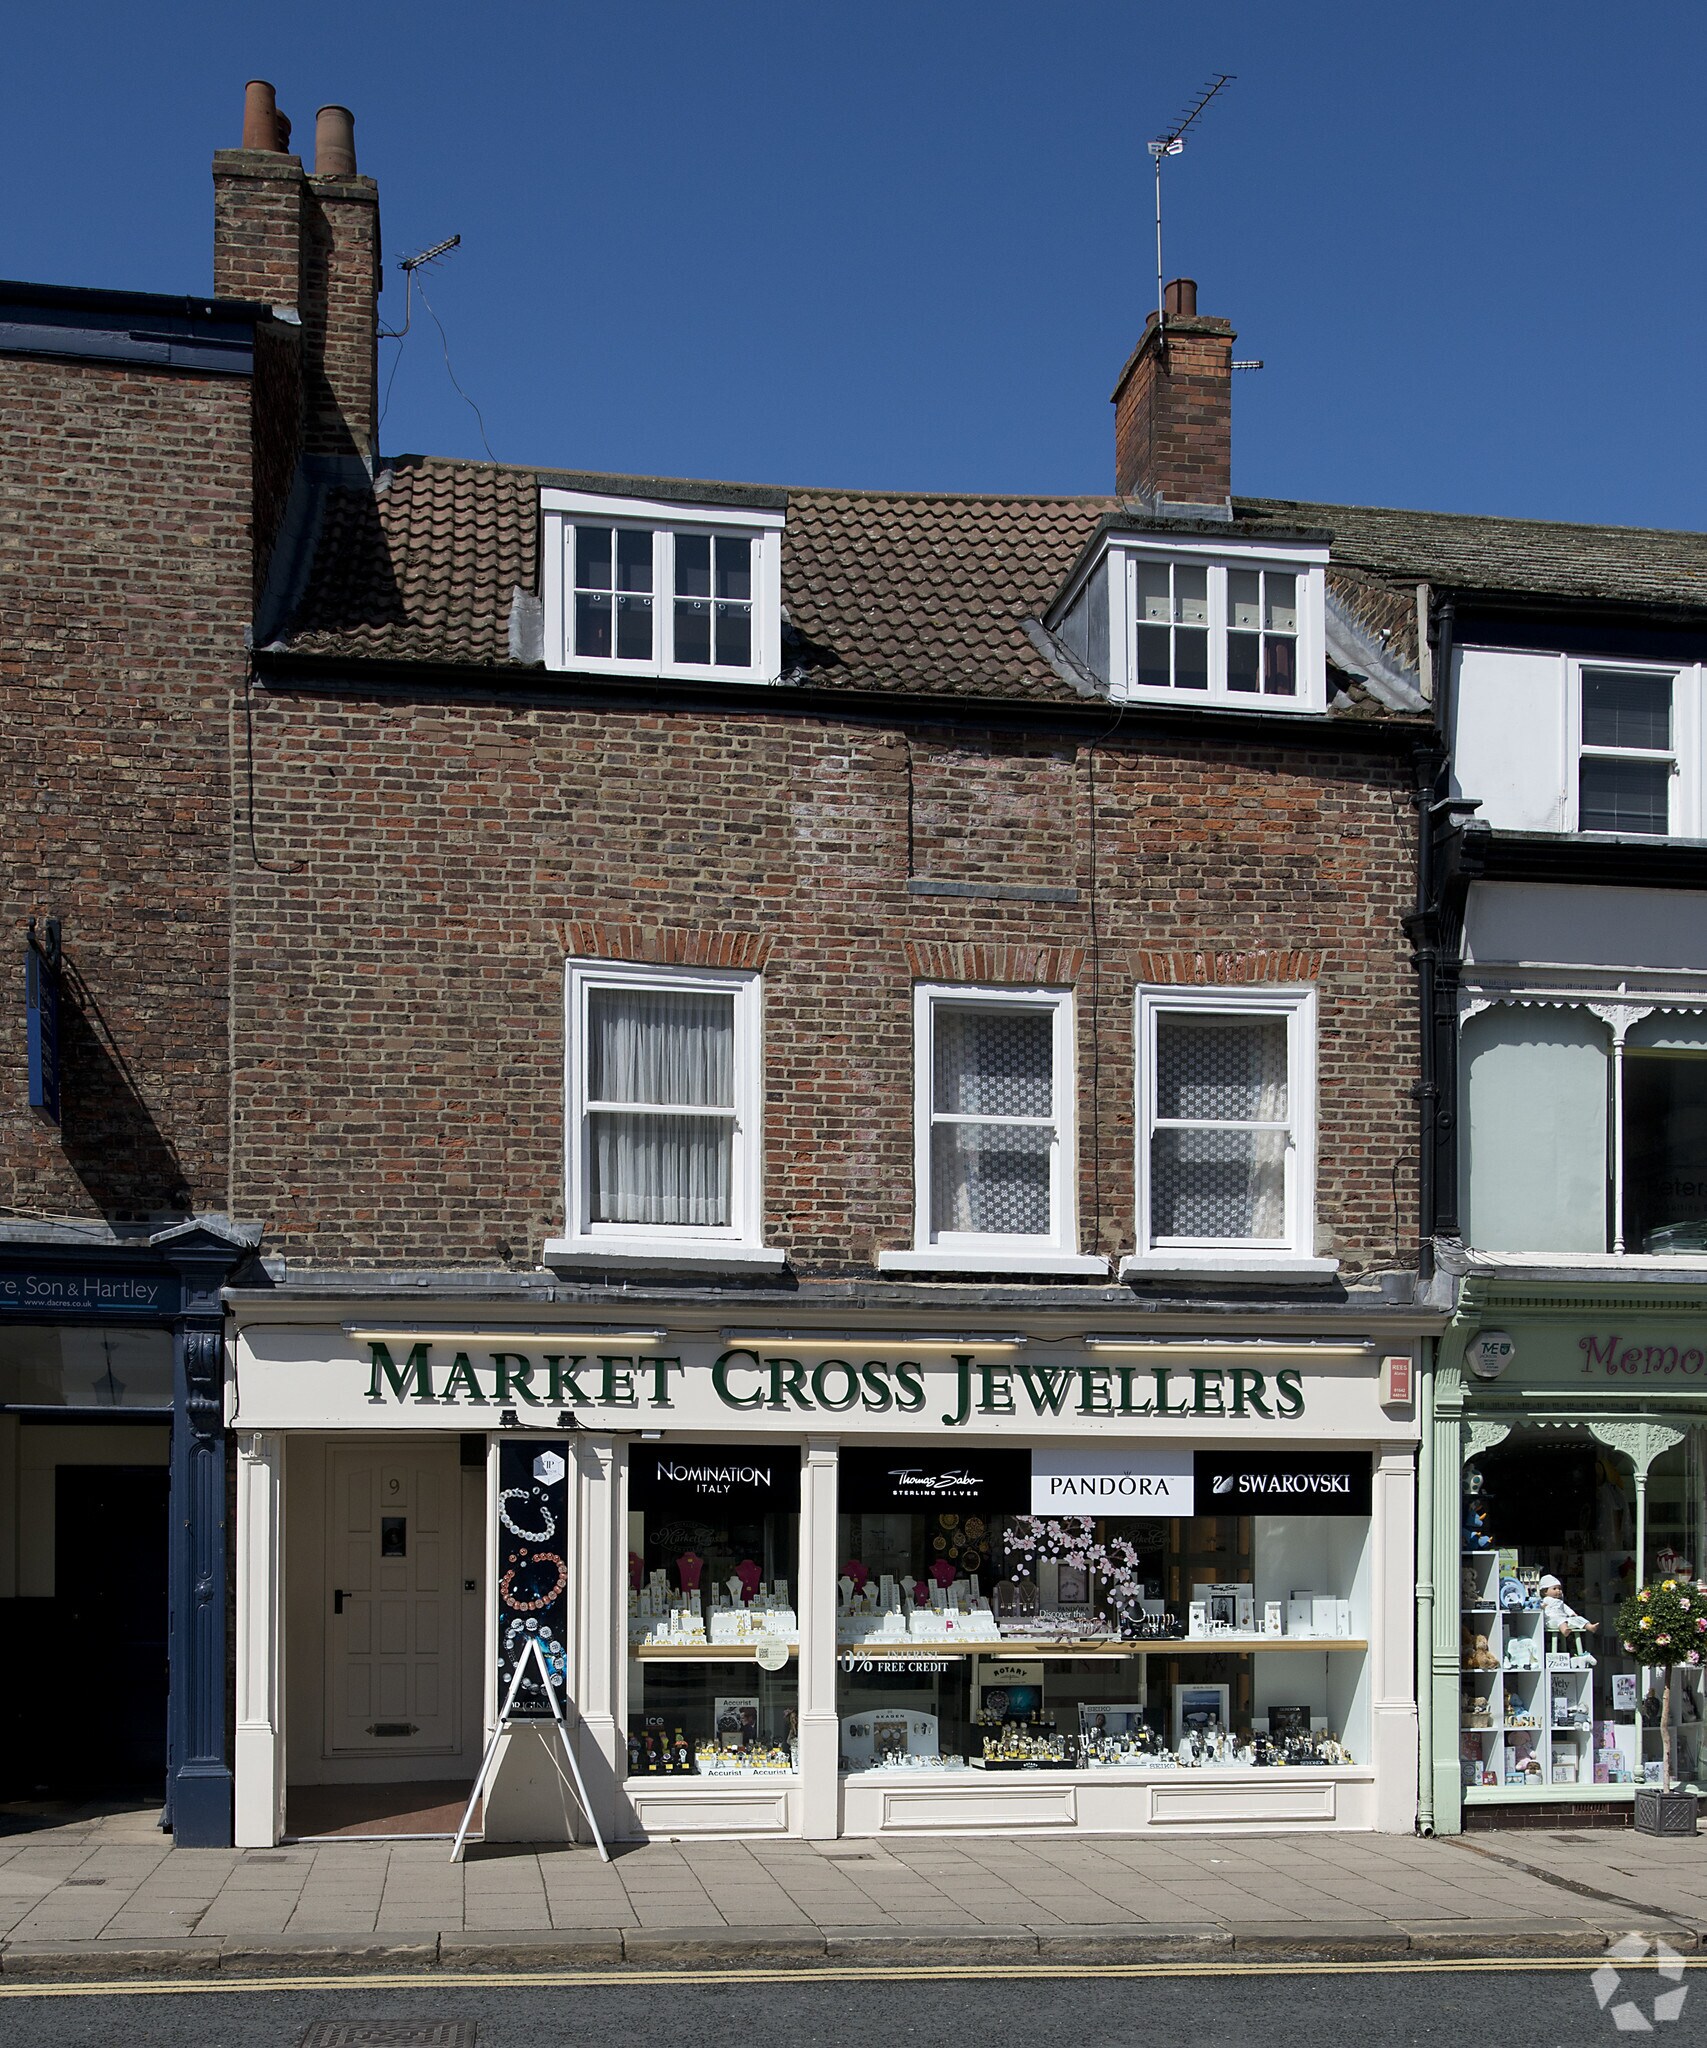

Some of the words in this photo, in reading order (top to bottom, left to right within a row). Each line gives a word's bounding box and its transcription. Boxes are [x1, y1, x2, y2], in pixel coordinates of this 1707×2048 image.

[26, 1276, 63, 1296] Son
[67, 1282, 79, 1296] &
[83, 1278, 158, 1304] Hartley
[24, 1299, 92, 1308] www.dacres.co.uk
[1578, 1335, 1707, 1376] Memo
[364, 1342, 682, 1403] MARKET
[712, 1348, 924, 1407] CROSS
[941, 1354, 1305, 1426] JEWELLERS
[389, 1478, 400, 1496] 9
[696, 1484, 731, 1493] ITALY
[887, 1469, 936, 1488] Thomas
[933, 1469, 984, 1489] Sabo
[1050, 1474, 1170, 1496] PANDORA
[1238, 1474, 1351, 1494] SWAROVSKI
[1039, 1609, 1072, 1619] Discover
[1073, 1609, 1086, 1619] the
[841, 1649, 873, 1673] 0%
[887, 1649, 940, 1660] INTEREST
[877, 1661, 906, 1673] FREE
[907, 1661, 949, 1673] CREDIT
[993, 1666, 1028, 1677] ROTARY
